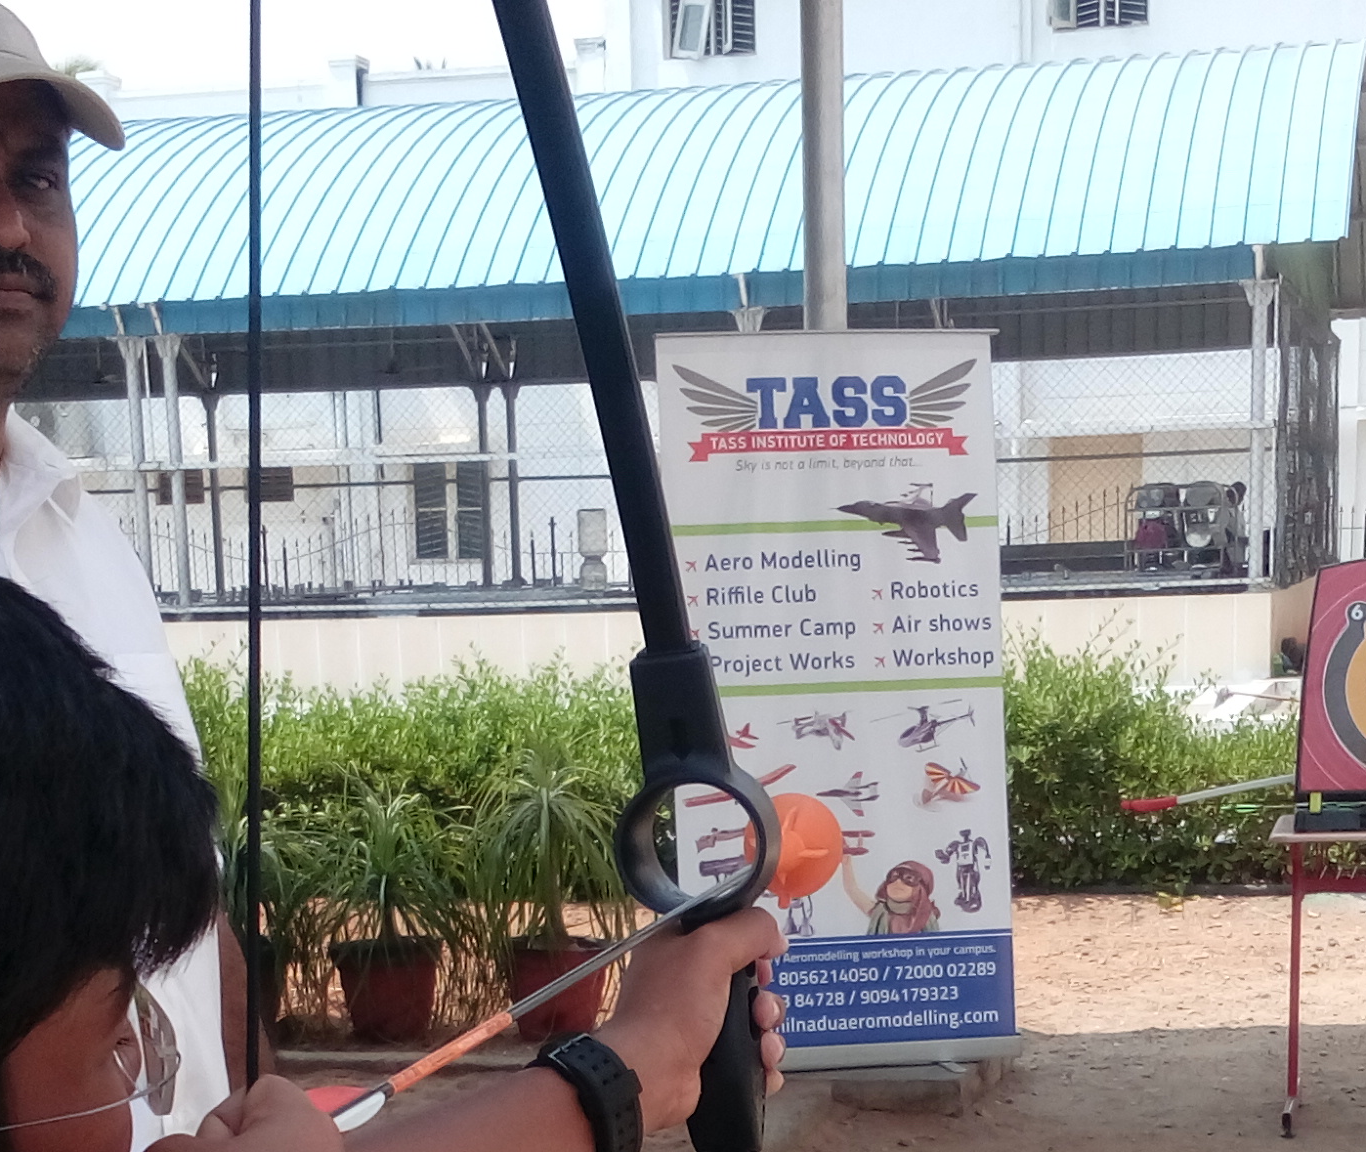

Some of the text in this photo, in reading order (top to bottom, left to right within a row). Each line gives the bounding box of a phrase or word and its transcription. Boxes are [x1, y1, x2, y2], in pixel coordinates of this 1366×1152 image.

[745, 375, 908, 430] TASS
[710, 431, 945, 450] TASS INSTITUTE OF TECHNOLOGY
[735, 458, 757, 474] Sky
[761, 458, 772, 470] is
[775, 459, 794, 471] not
[797, 461, 805, 470] a
[808, 456, 840, 471] limit,
[843, 455, 886, 471] beyond
[704, 548, 862, 573] Aero Modelling
[706, 584, 817, 606] Riffile Club
[890, 581, 980, 600] Robotics
[1350, 604, 1364, 621] 6
[707, 617, 857, 641] Summer Camp
[891, 613, 992, 635] Air shows
[710, 650, 856, 678] Project Works
[892, 647, 995, 669] Workshop
[783, 949, 860, 964] Aeromodelling
[861, 946, 914, 961] workshop
[915, 946, 926, 956] in
[927, 946, 951, 959] your
[953, 944, 997, 957] campus.
[778, 961, 997, 987] 8056214050 / 72000 02289
[794, 991, 845, 1008] 84728
[848, 990, 856, 1006] /
[860, 985, 960, 1005] 9094179323
